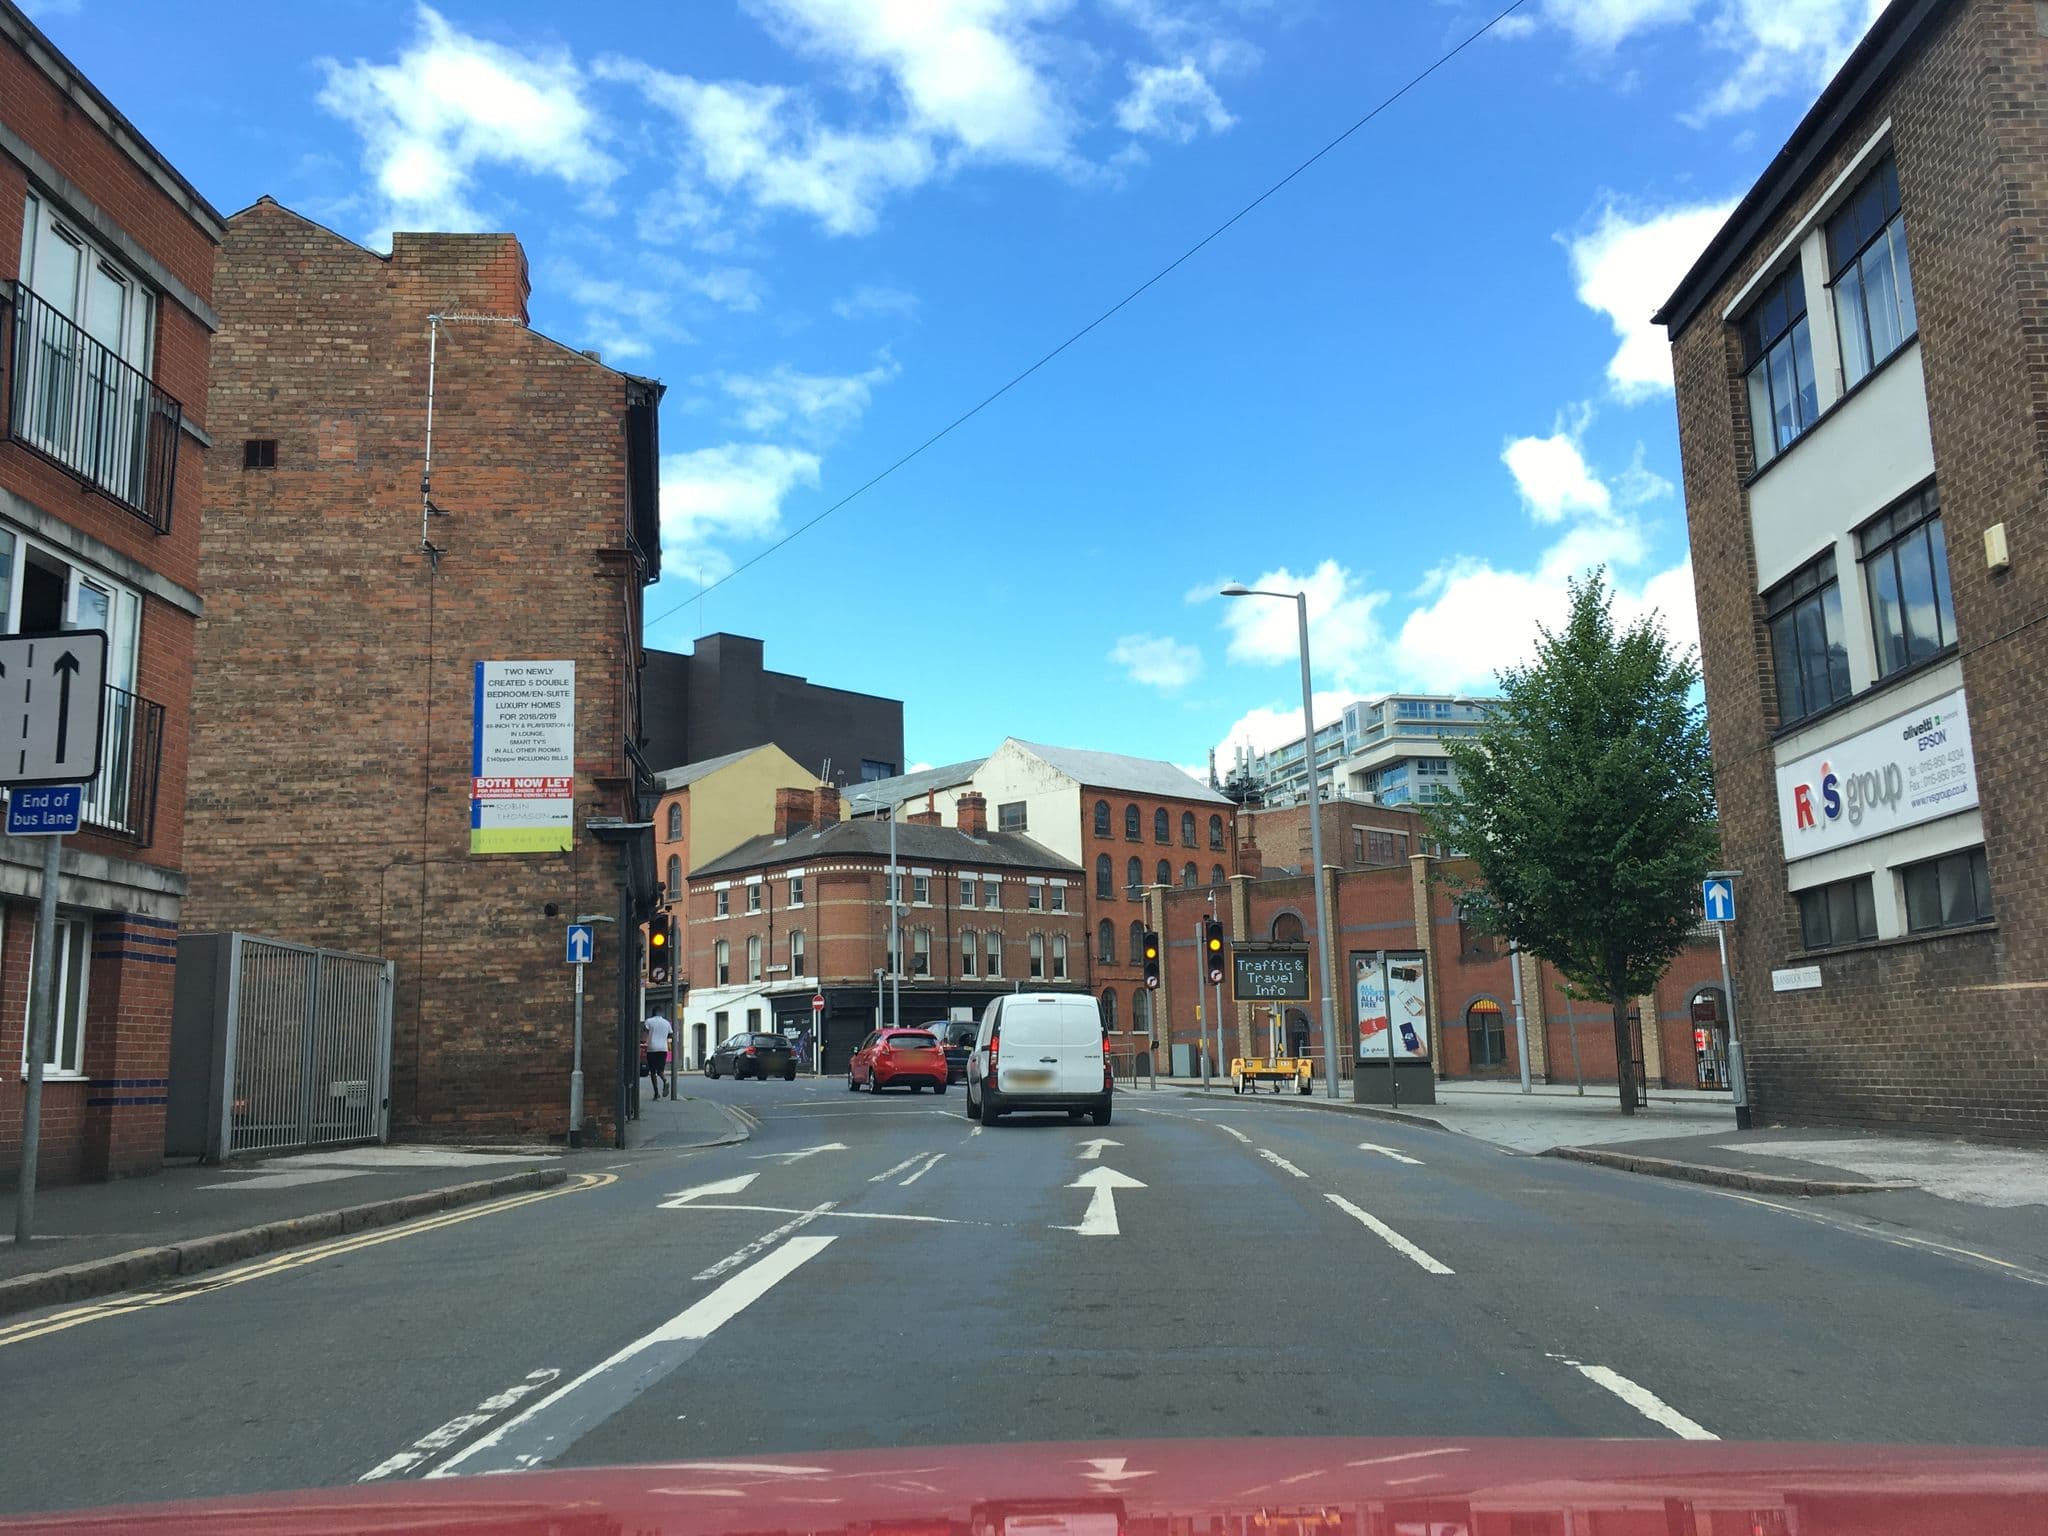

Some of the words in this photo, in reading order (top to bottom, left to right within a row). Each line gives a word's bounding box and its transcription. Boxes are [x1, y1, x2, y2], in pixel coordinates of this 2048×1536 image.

[487, 690, 570, 698] BEDROOM/EN-SUITE
[531, 701, 561, 709] HOMES
[1903, 717, 1933, 741] olivetti
[1918, 729, 1947, 752] EPSON
[477, 779, 511, 788] BOTH
[514, 779, 543, 788] NOW
[547, 778, 570, 788] LET
[1846, 762, 1903, 826] group
[22, 793, 50, 808] End
[54, 793, 70, 807] of
[13, 812, 39, 826] bus
[42, 811, 74, 825] lane
[1237, 960, 1293, 971] Traffic
[1295, 960, 1304, 971] &
[1247, 972, 1294, 984] Travel
[1255, 985, 1286, 996] Info
